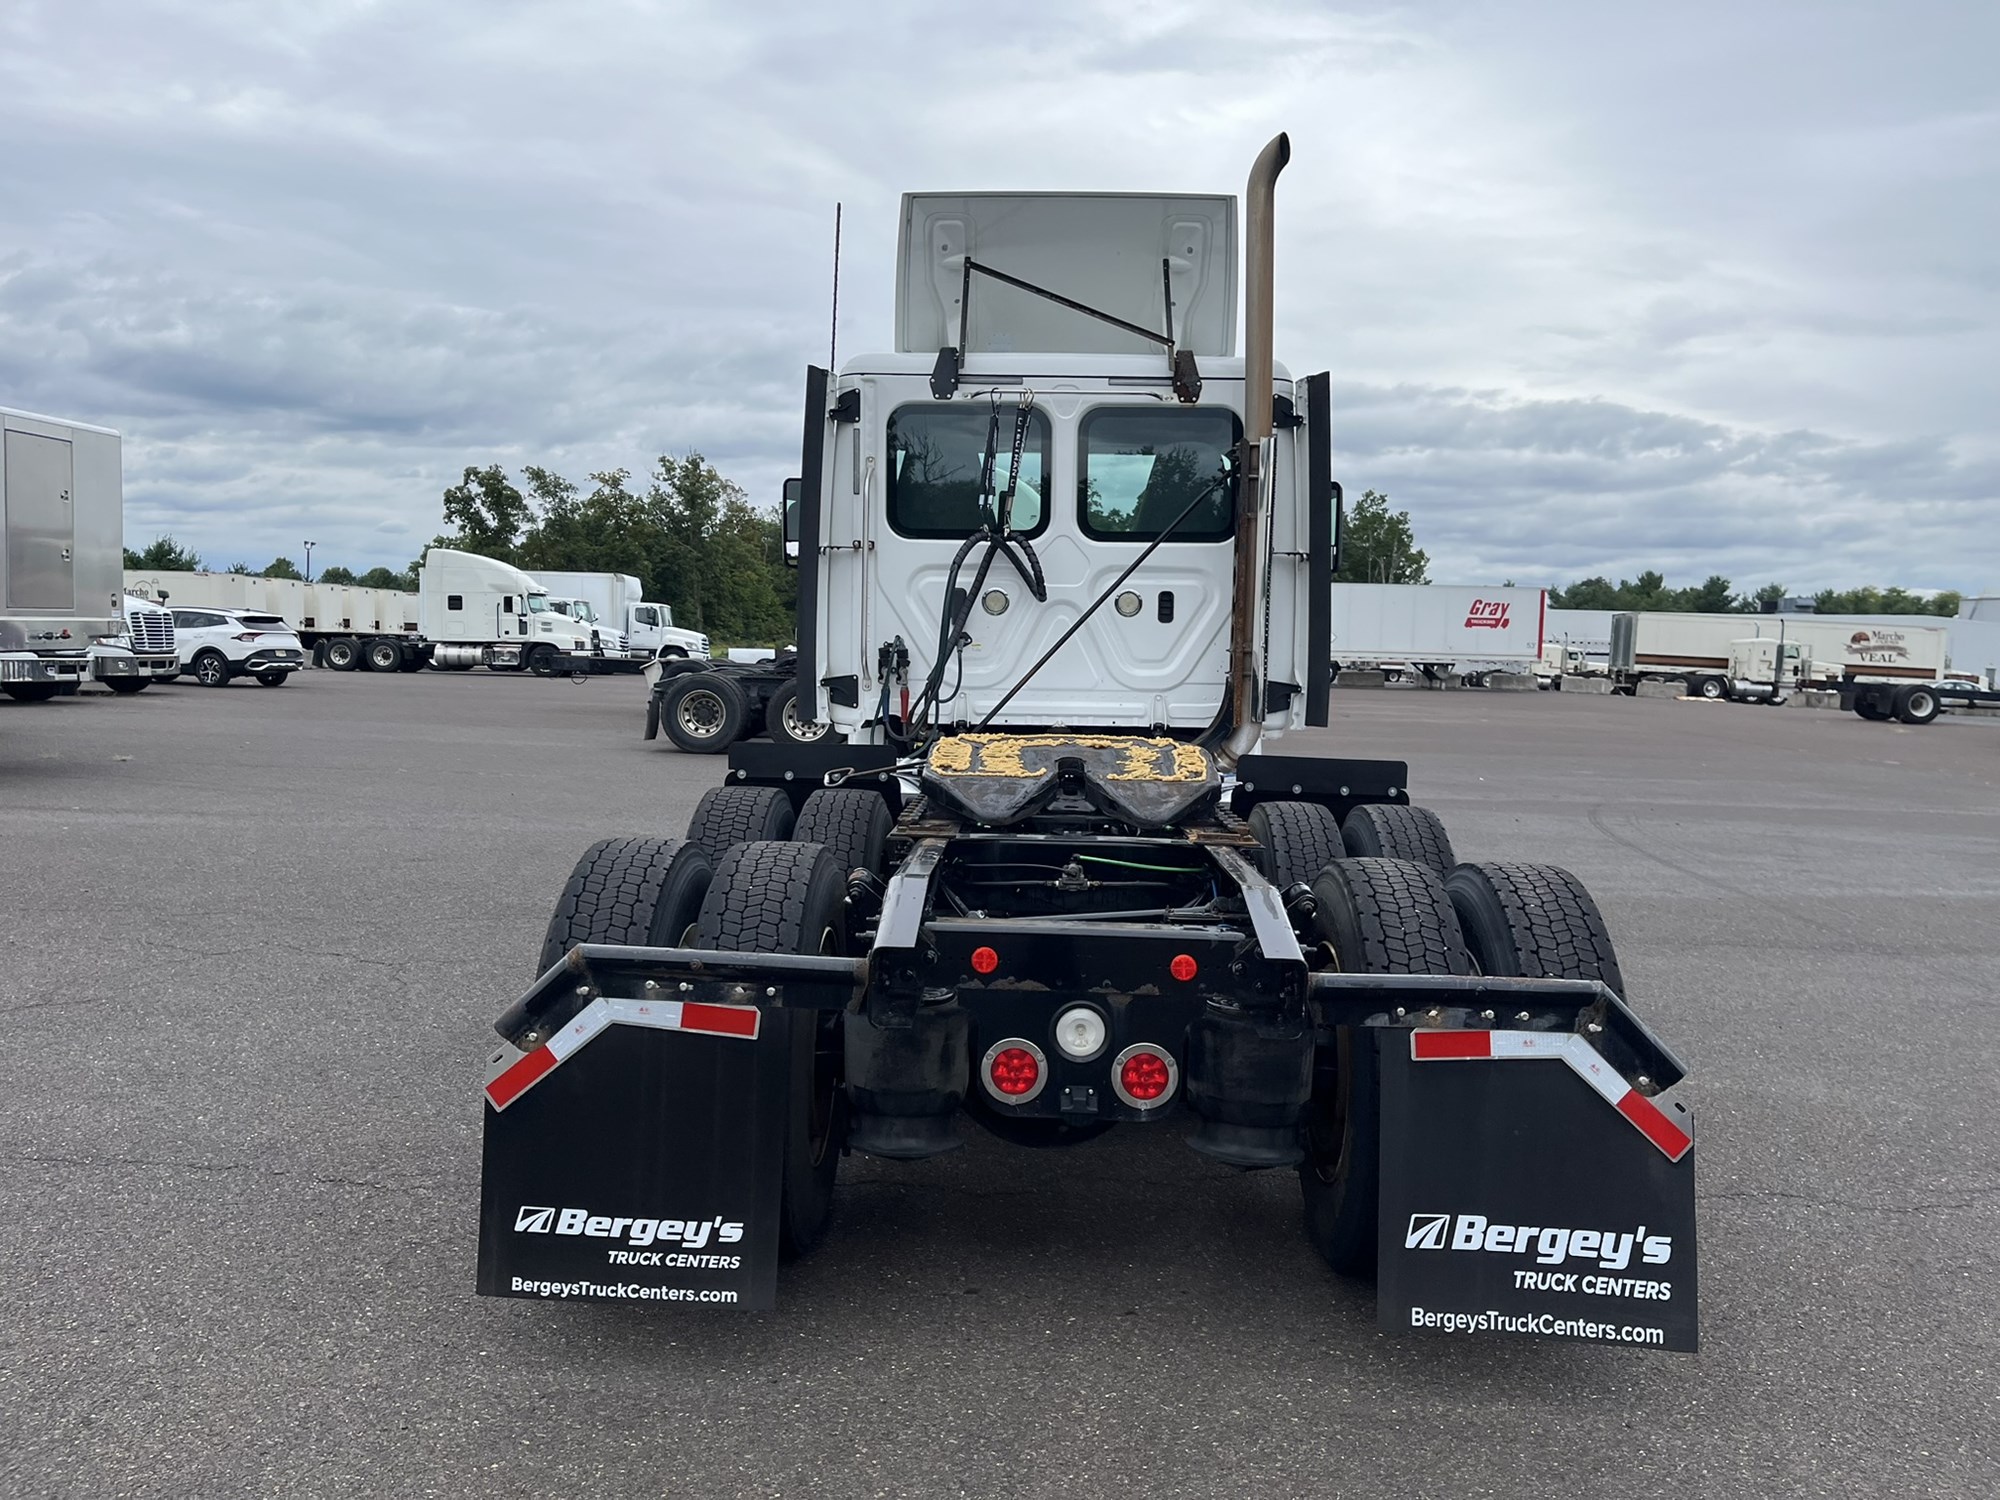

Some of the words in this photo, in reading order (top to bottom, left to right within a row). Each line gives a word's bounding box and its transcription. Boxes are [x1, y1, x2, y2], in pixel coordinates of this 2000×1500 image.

[1469, 599, 1510, 619] Gray
[1872, 630, 1905, 641] Marcho
[1860, 652, 1896, 663] VEAL
[555, 1207, 745, 1248] Bergey's
[1451, 1214, 1673, 1270] Bergey's
[607, 1250, 664, 1267] TRUCK
[665, 1253, 742, 1270] CENTERS
[511, 1276, 739, 1303] BergeysTruckCenters.com
[1513, 1270, 1578, 1293] TRUCK
[1581, 1275, 1672, 1301] CENTERS
[1410, 1306, 1664, 1345] BergeysTruckCenters.com
